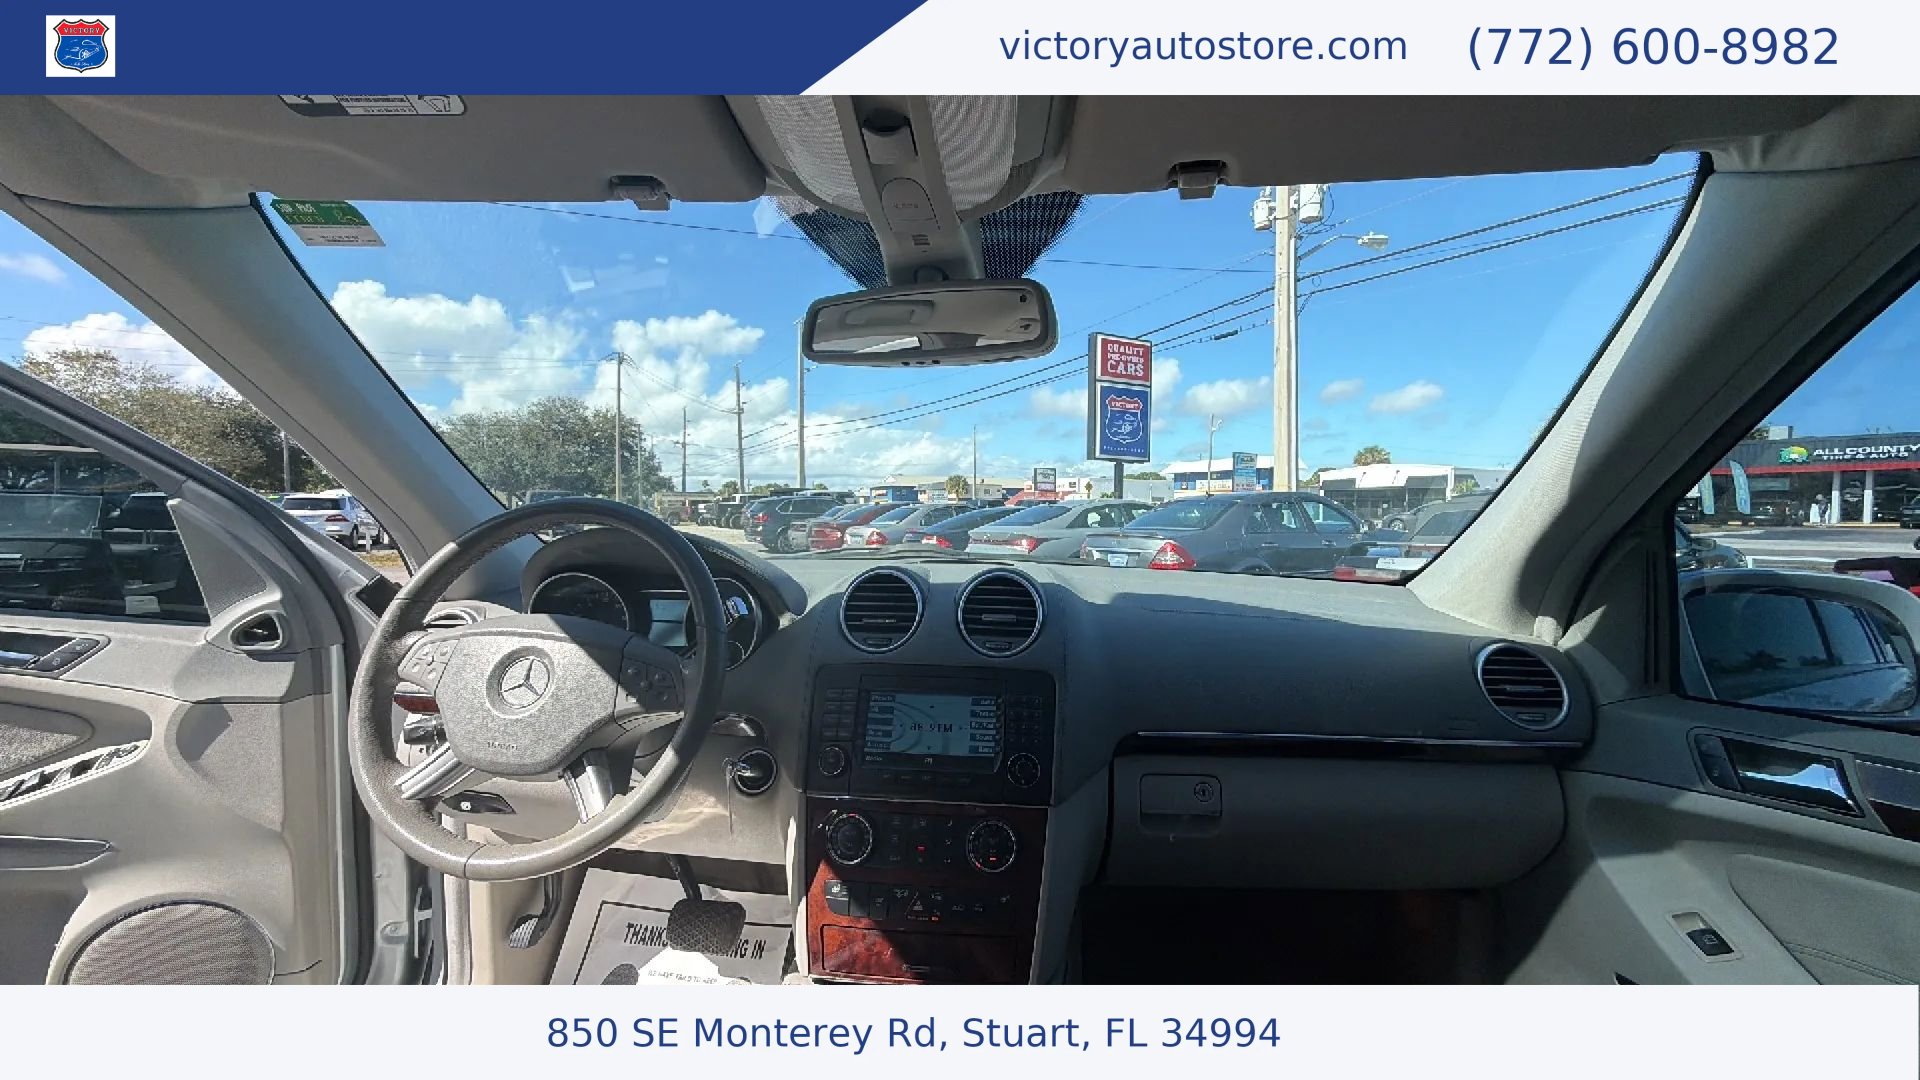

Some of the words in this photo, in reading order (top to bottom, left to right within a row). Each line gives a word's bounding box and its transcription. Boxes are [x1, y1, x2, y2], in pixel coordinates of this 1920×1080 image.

[1107, 343, 1144, 356] QUALITY
[1107, 359, 1144, 377] CARS
[1813, 448, 1844, 456] ALL
[1846, 443, 1920, 454] COUNTY
[750, 939, 767, 960] IN
